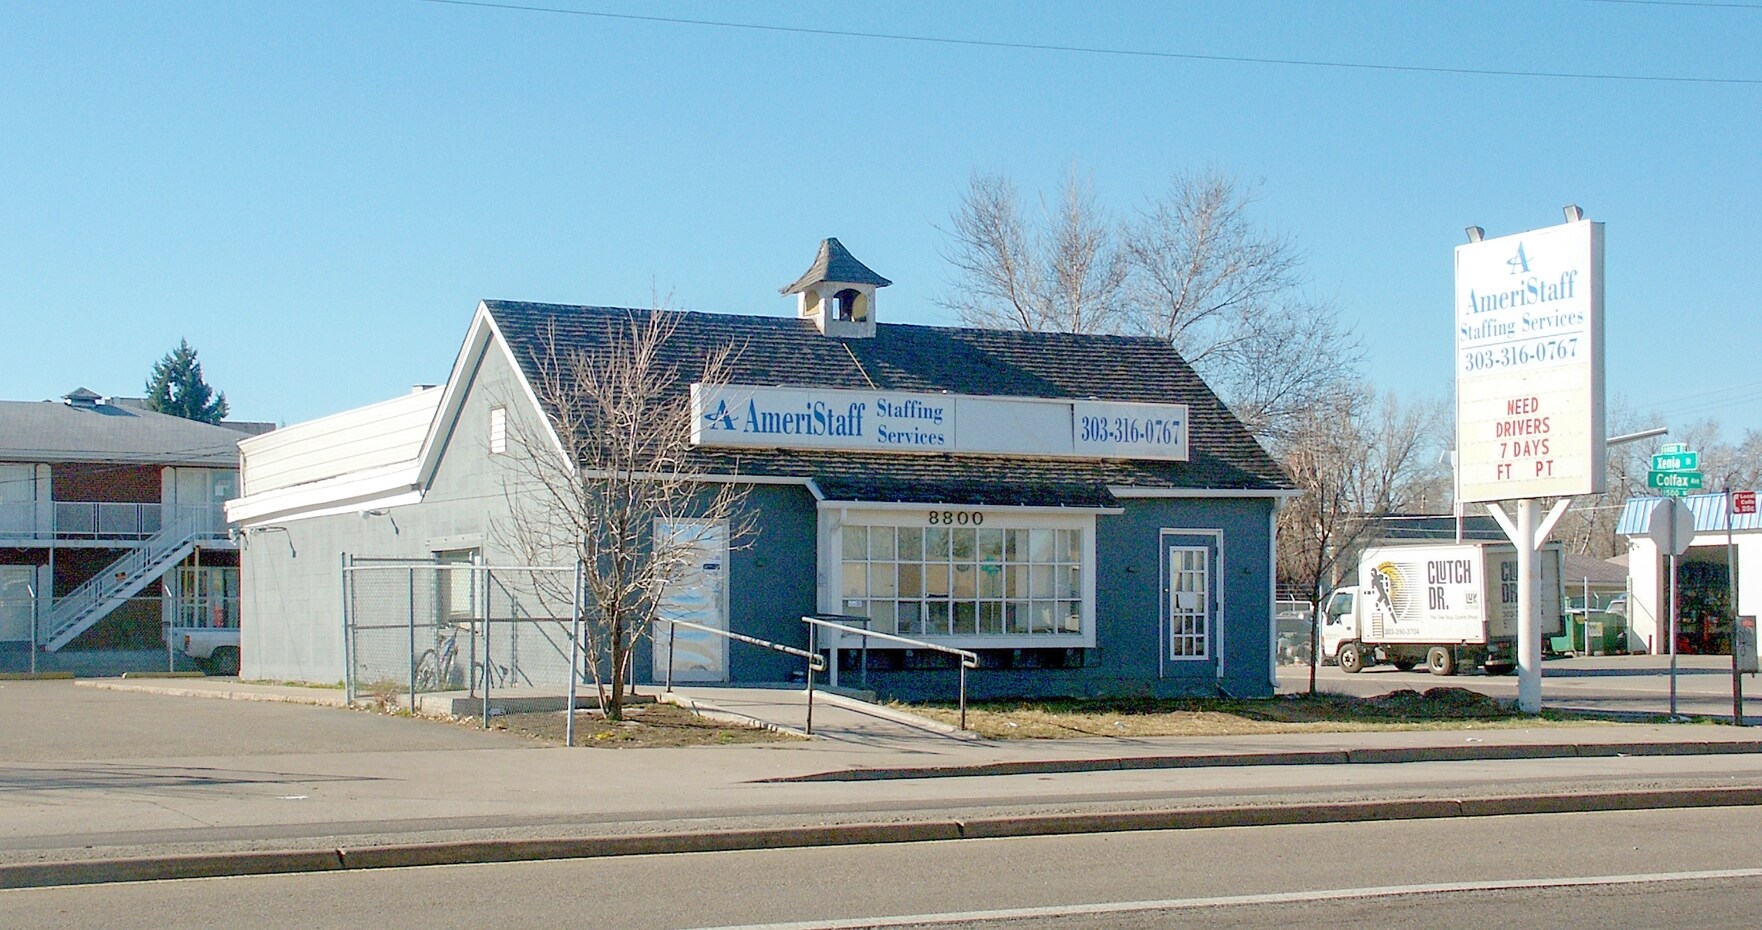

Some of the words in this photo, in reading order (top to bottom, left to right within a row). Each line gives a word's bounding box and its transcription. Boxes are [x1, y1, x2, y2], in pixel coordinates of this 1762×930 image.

[1465, 269, 1577, 315] AmeriStaff
[1460, 317, 1515, 342] Staffing
[1522, 308, 1584, 332] Services
[1465, 338, 1577, 372] 303-316-0767
[743, 398, 866, 437] AmeriStaff
[877, 398, 944, 425] Staffing
[1507, 397, 1539, 416] NEED
[878, 424, 945, 445] Services
[1081, 416, 1180, 445] 303-316-0767
[1496, 417, 1550, 438] DRIVERS
[1500, 442, 1507, 459] 7
[1513, 439, 1550, 457] DAYS
[1497, 463, 1512, 480] FT
[1535, 460, 1554, 477] PT
[1656, 456, 1681, 470] Xenia
[1656, 473, 1689, 487] Colfax
[929, 511, 984, 525] 8800
[1427, 559, 1471, 585] CLUTCH
[1428, 586, 1449, 610] DR.
